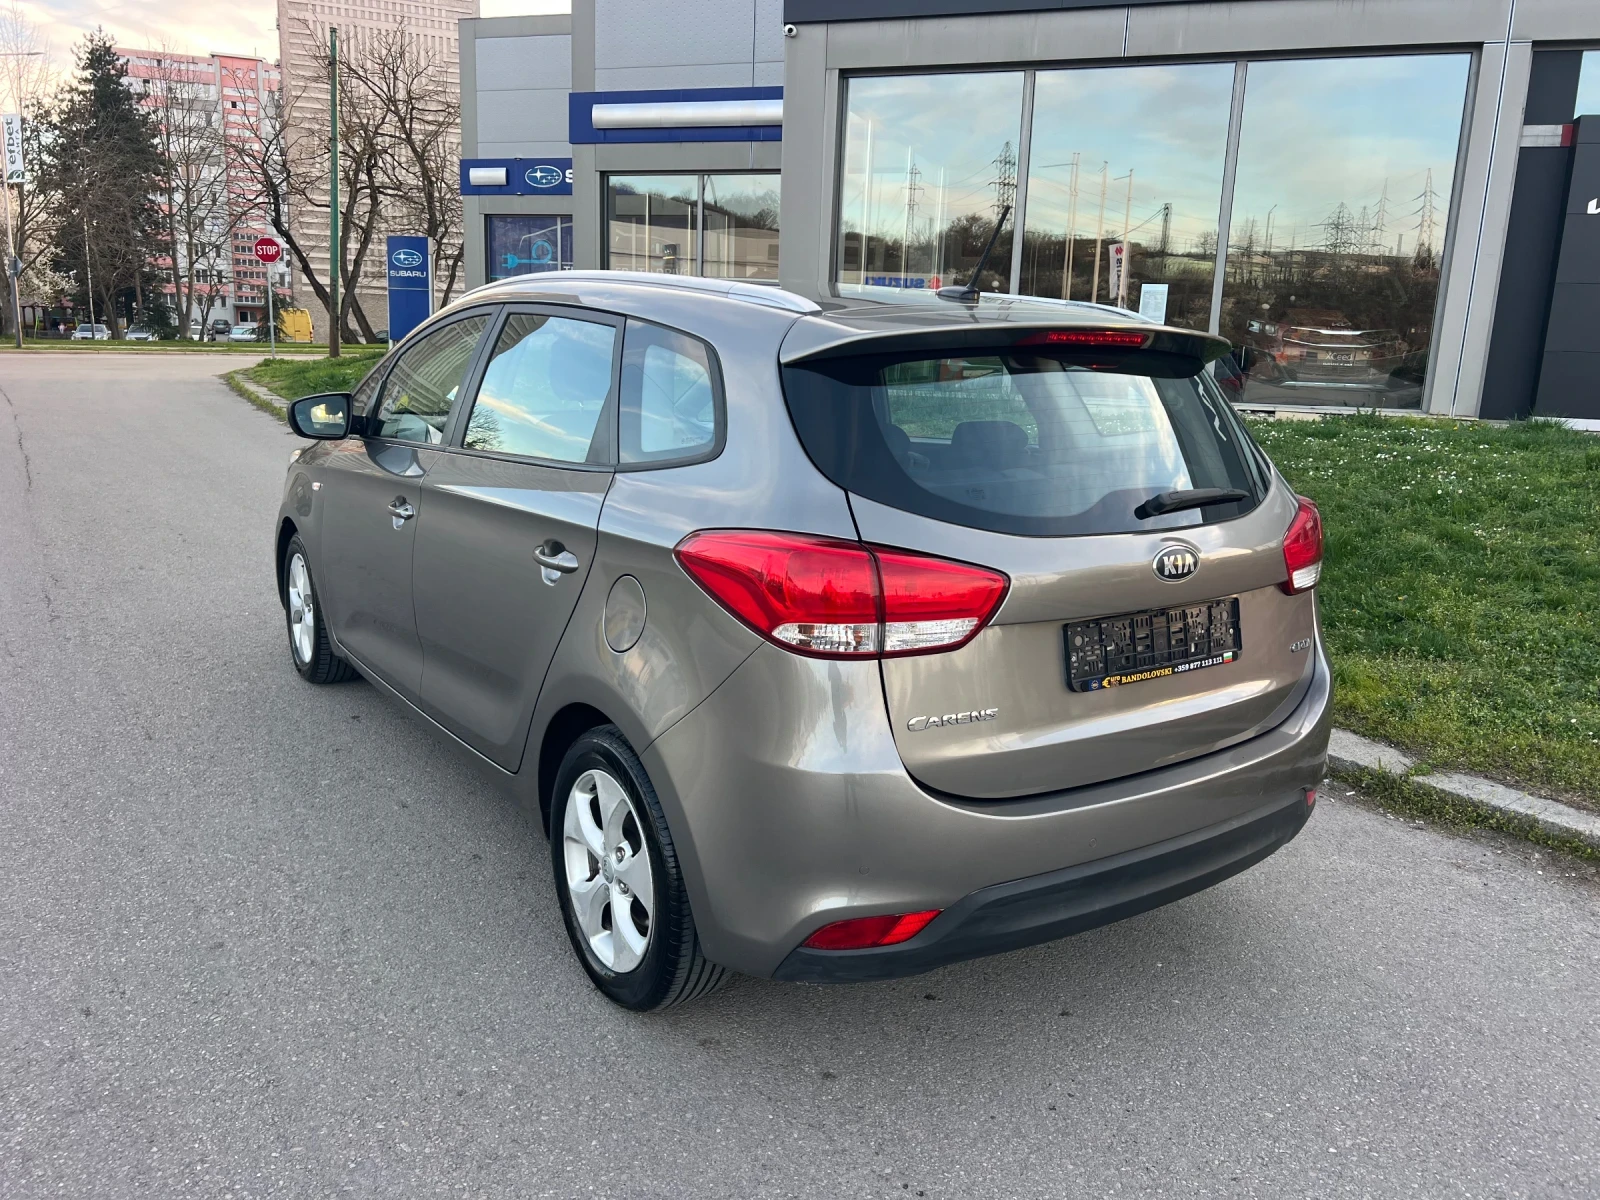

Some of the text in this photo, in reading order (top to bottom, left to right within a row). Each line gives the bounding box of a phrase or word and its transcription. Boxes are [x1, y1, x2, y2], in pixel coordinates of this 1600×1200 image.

[5, 118, 16, 165] efbet
[257, 245, 278, 255] STOP
[1325, 351, 1353, 361] XCeed
[1163, 553, 1195, 575] KIA
[1121, 667, 1172, 684] BANDOLOVSKI
[1174, 663, 1189, 672] +359
[1190, 661, 1201, 669] 877
[1213, 656, 1222, 665] 111
[907, 708, 999, 732] CARENS
